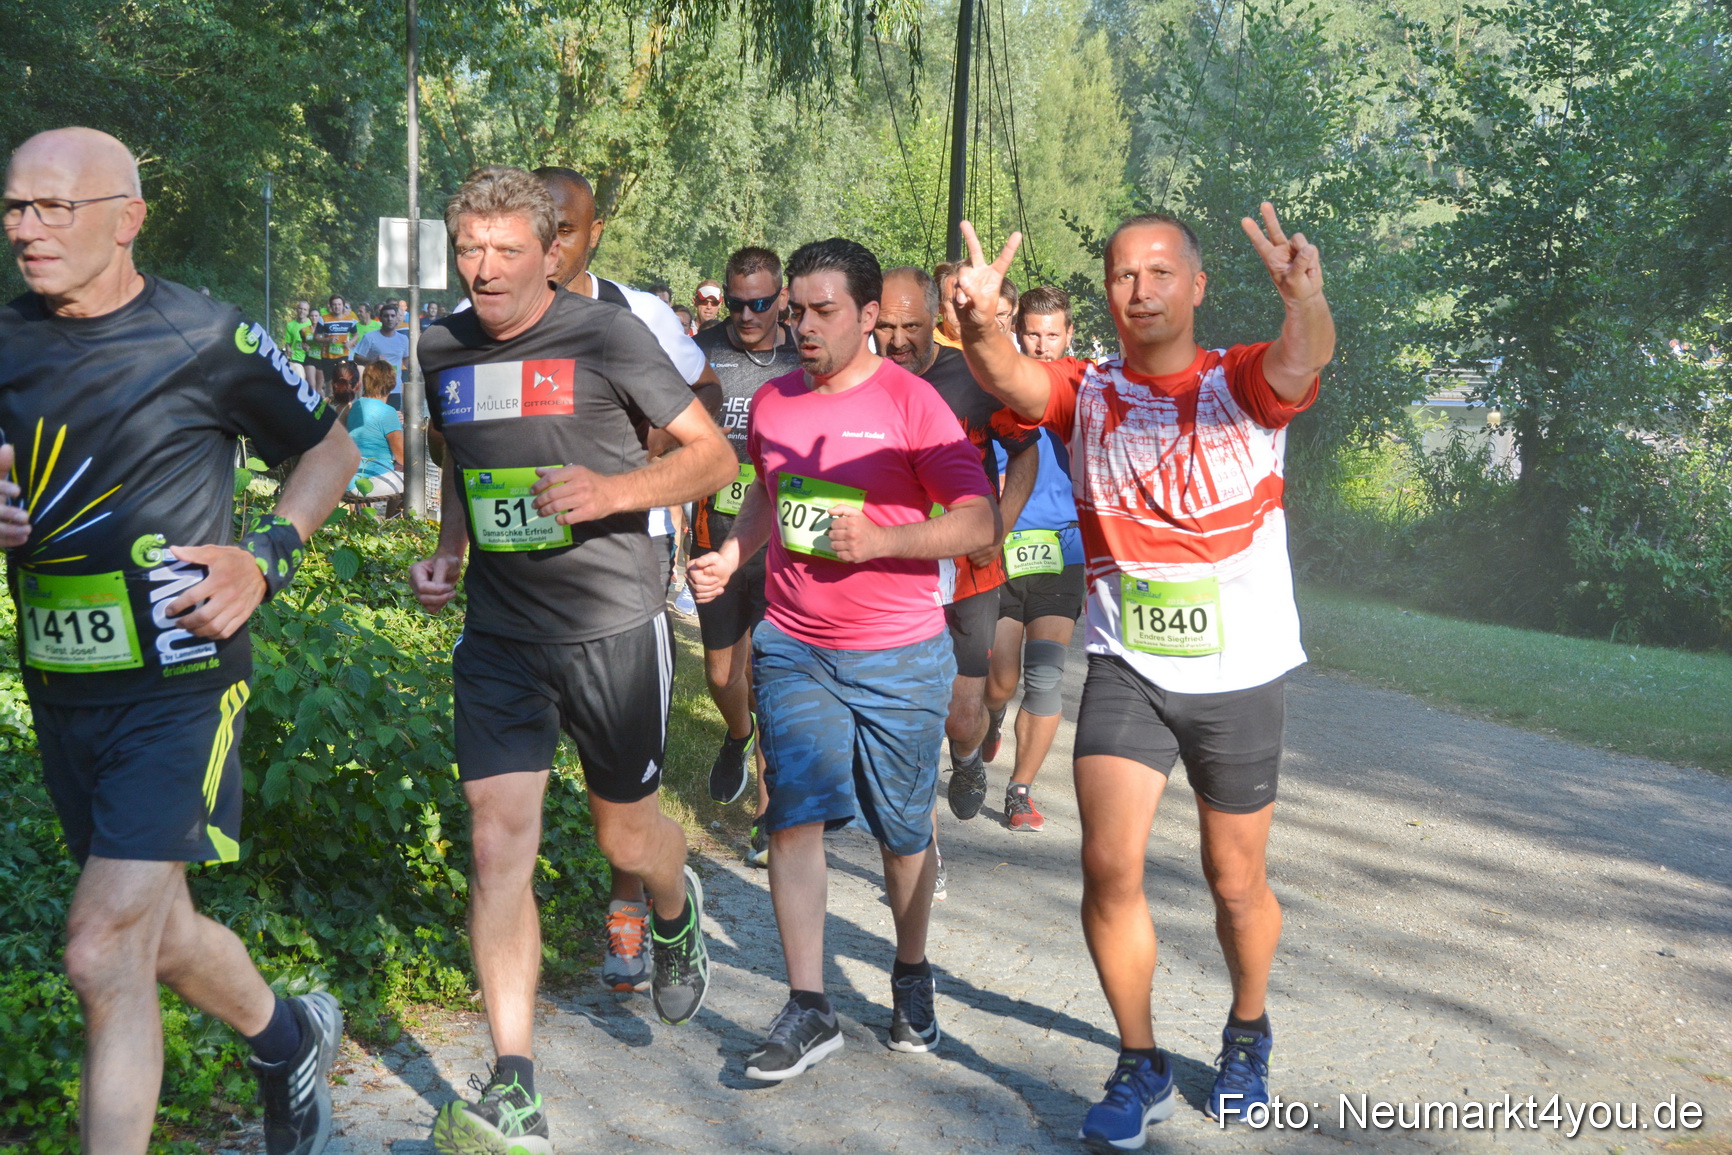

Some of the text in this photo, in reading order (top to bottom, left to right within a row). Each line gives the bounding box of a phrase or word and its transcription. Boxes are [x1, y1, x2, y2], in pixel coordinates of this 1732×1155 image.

[476, 395, 519, 411] MÜLLER
[842, 430, 863, 438] Ahmad
[494, 498, 528, 528] 51
[483, 527, 553, 537] Damaschke Erfried
[1016, 544, 1052, 562] 672
[28, 607, 115, 645] 1418
[1132, 605, 1207, 634] 1840
[1139, 632, 1204, 643] Endres Siegfried
[70, 645, 97, 655] Josef
